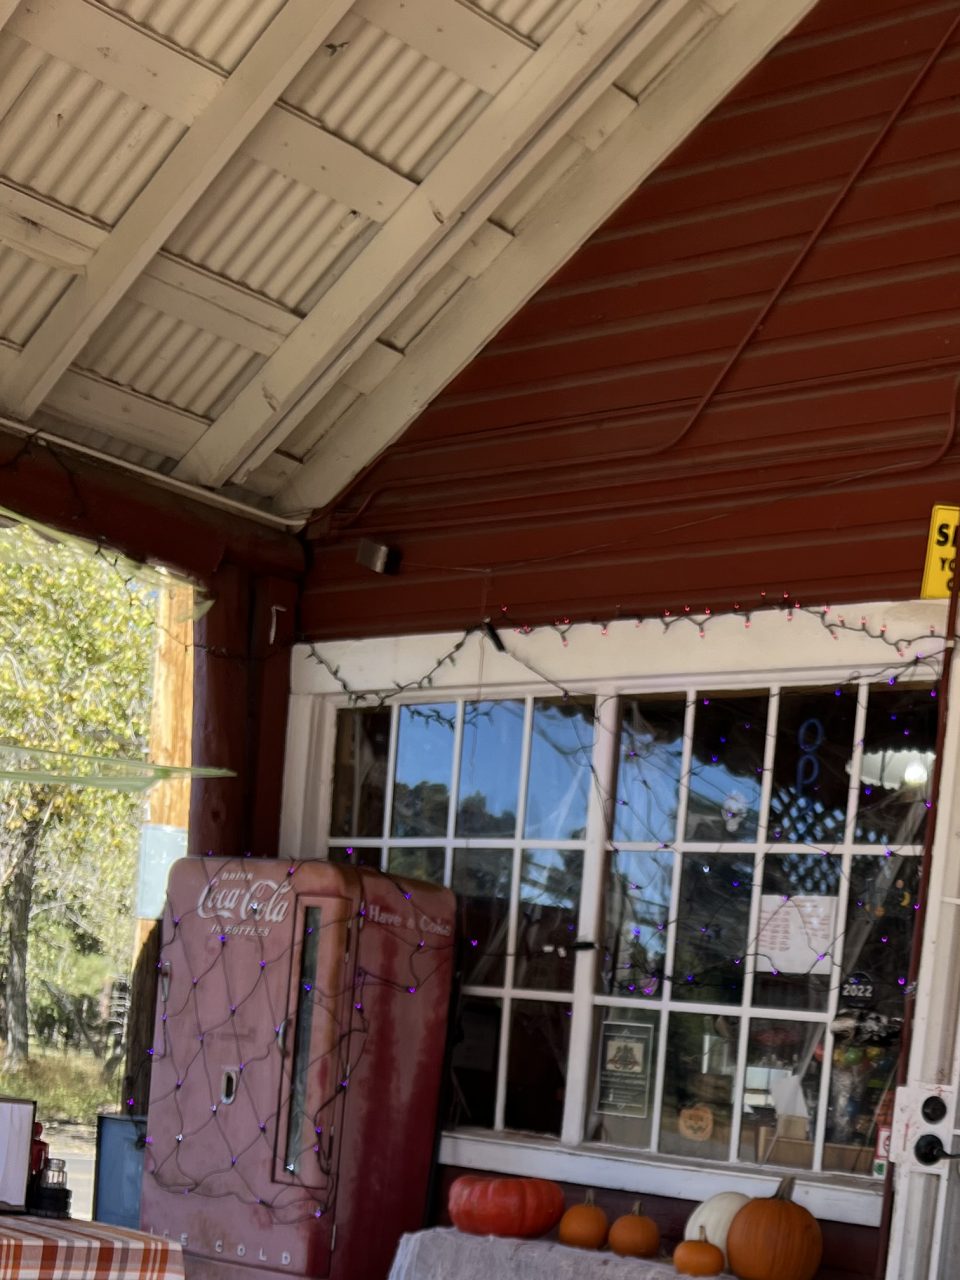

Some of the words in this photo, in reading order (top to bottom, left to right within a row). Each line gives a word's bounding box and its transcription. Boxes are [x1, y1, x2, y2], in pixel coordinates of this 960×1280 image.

[369, 905, 402, 926] Have
[842, 984, 873, 997] 2022
[215, 1239, 291, 1265] COLD
